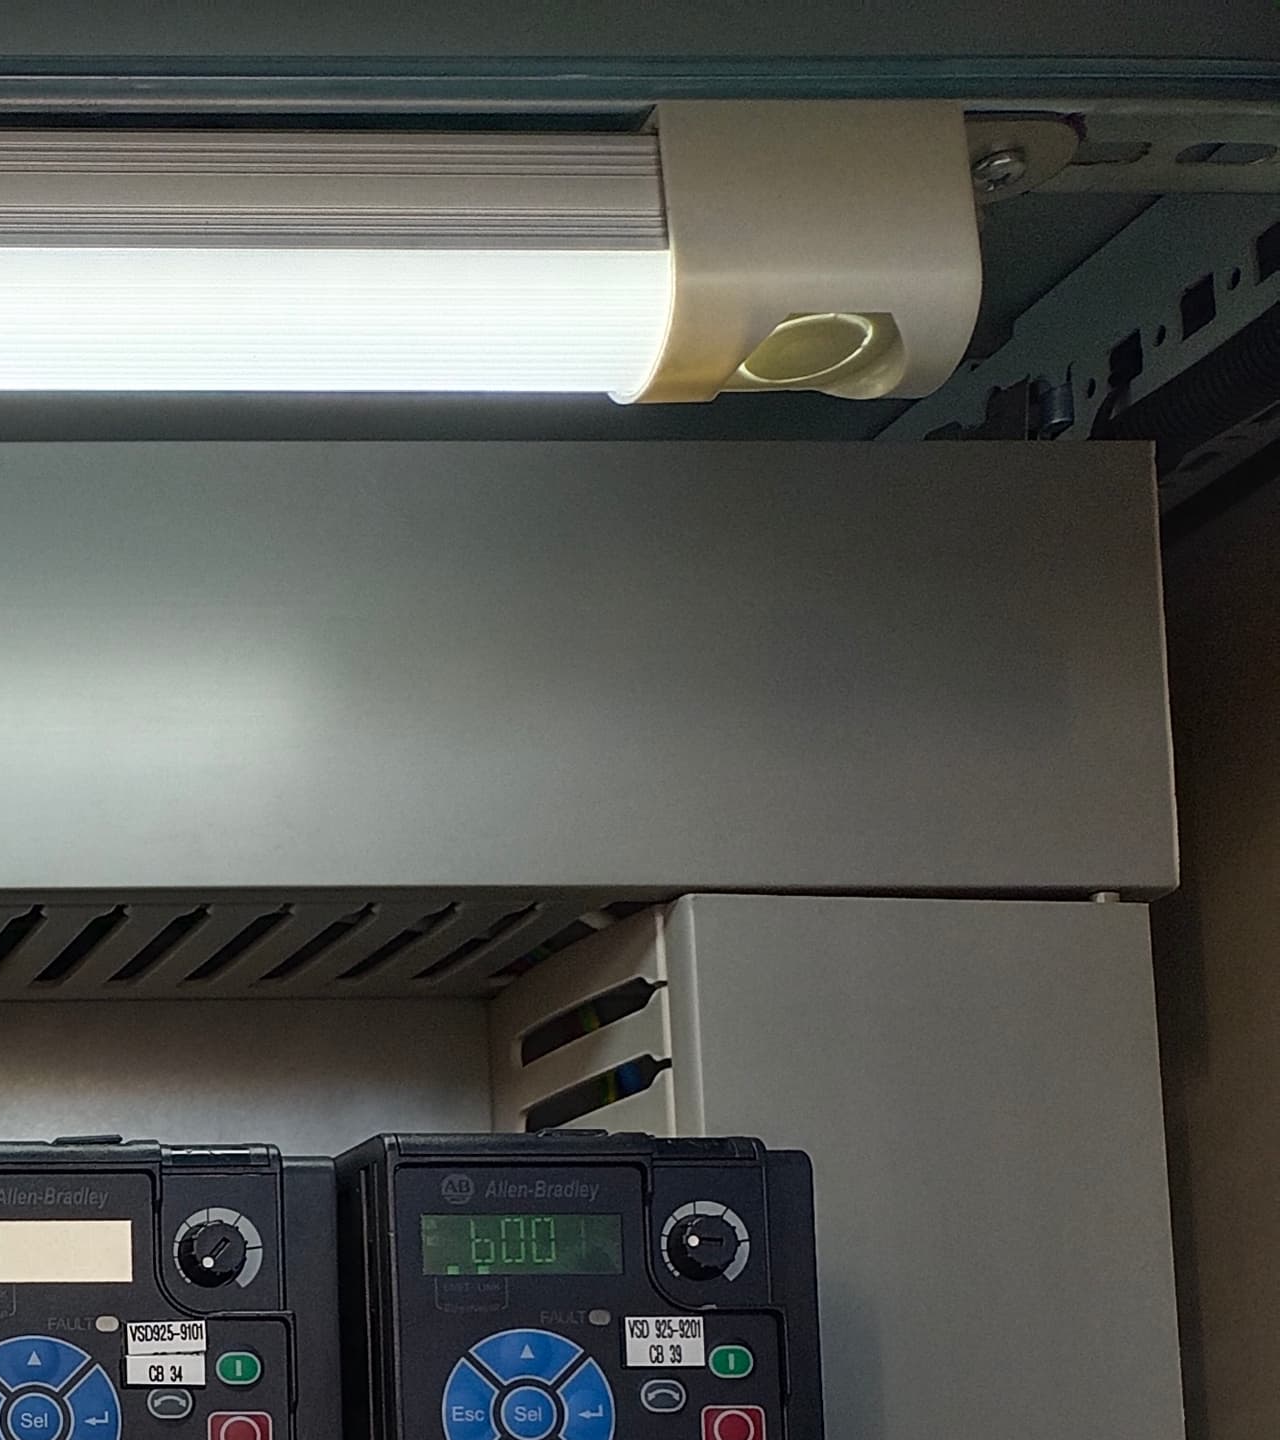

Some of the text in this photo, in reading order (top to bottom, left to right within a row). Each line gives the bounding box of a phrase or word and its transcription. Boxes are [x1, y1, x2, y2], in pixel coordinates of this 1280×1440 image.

[484, 1182, 599, 1203] Allen-Bradley
[129, 1324, 204, 1342] VSD925-9101
[628, 1319, 702, 1339] VSD 925-9201
[649, 1344, 682, 1364] CB 39
[148, 1365, 183, 1382] CB 34
[20, 1412, 49, 1428] Sel
[451, 1406, 485, 1422] Esc
[514, 1406, 542, 1422] Sel
